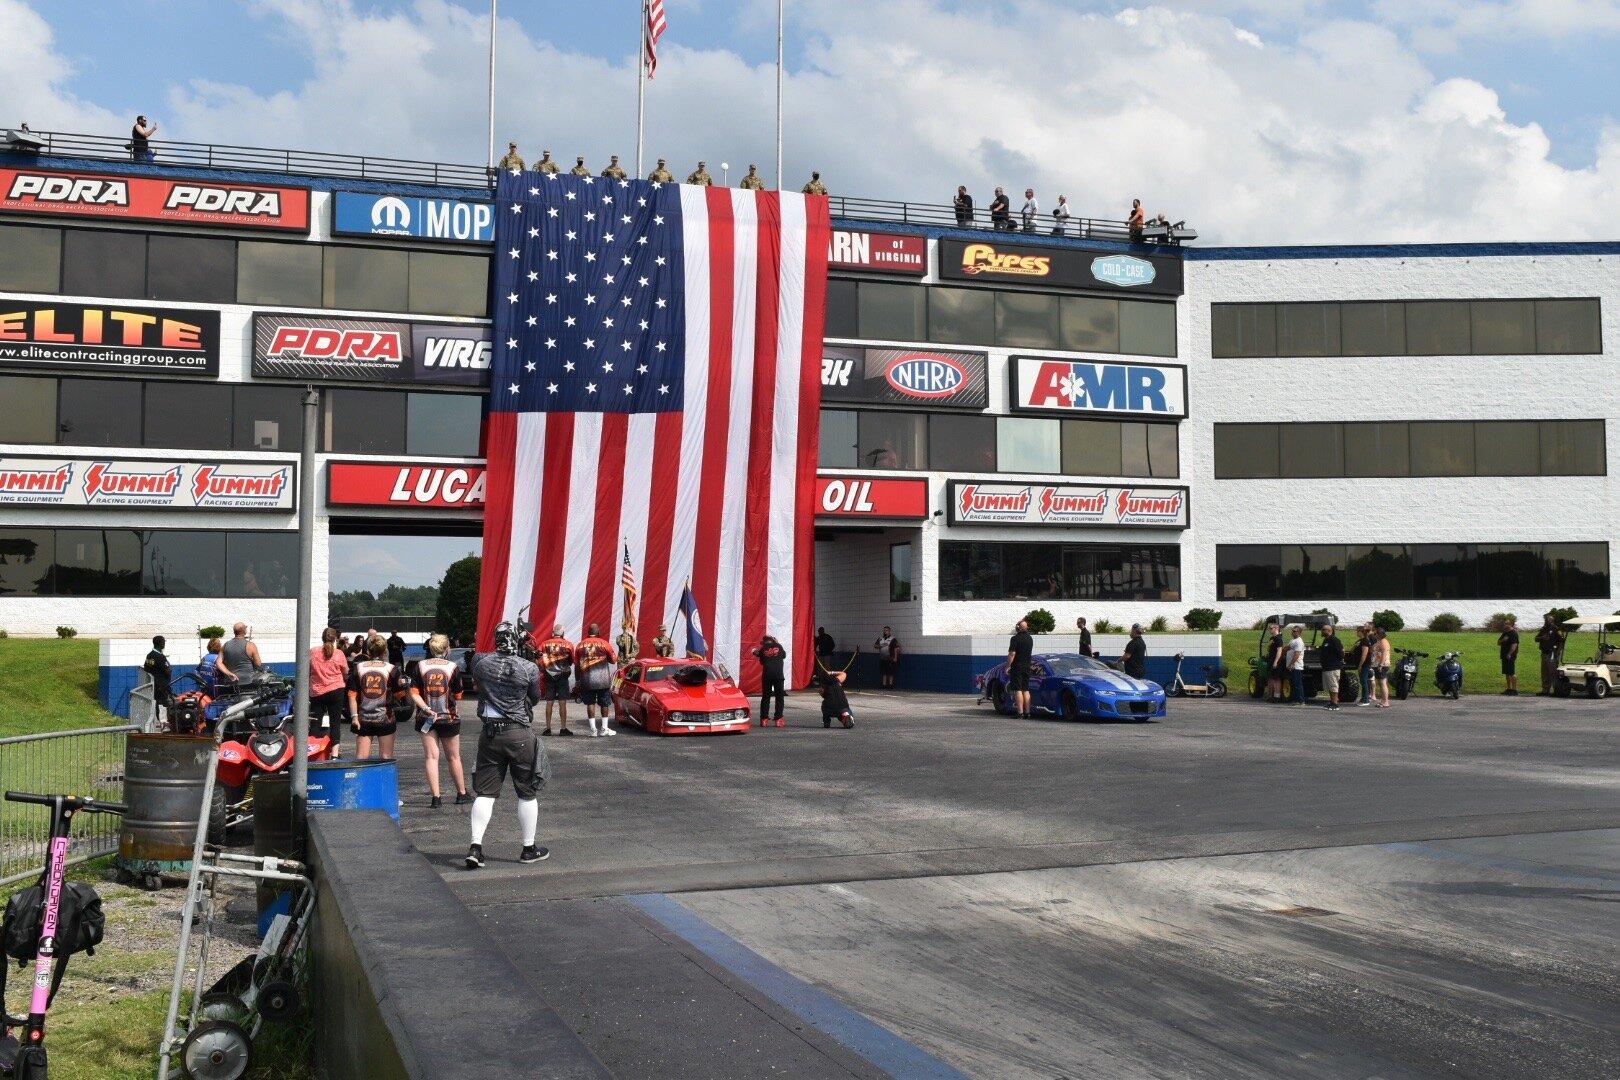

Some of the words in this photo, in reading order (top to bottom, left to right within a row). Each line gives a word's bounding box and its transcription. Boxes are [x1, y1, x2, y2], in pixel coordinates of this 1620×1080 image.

[9, 175, 128, 205] PDRA
[166, 185, 280, 215] PDRA
[427, 200, 495, 241] MOP
[875, 252, 921, 264] VIRGINIA
[0, 309, 202, 348] ELITE
[267, 326, 402, 363] PDRA
[898, 361, 956, 390] NHRA
[1028, 361, 1168, 412] AMR
[822, 480, 874, 512] OIL
